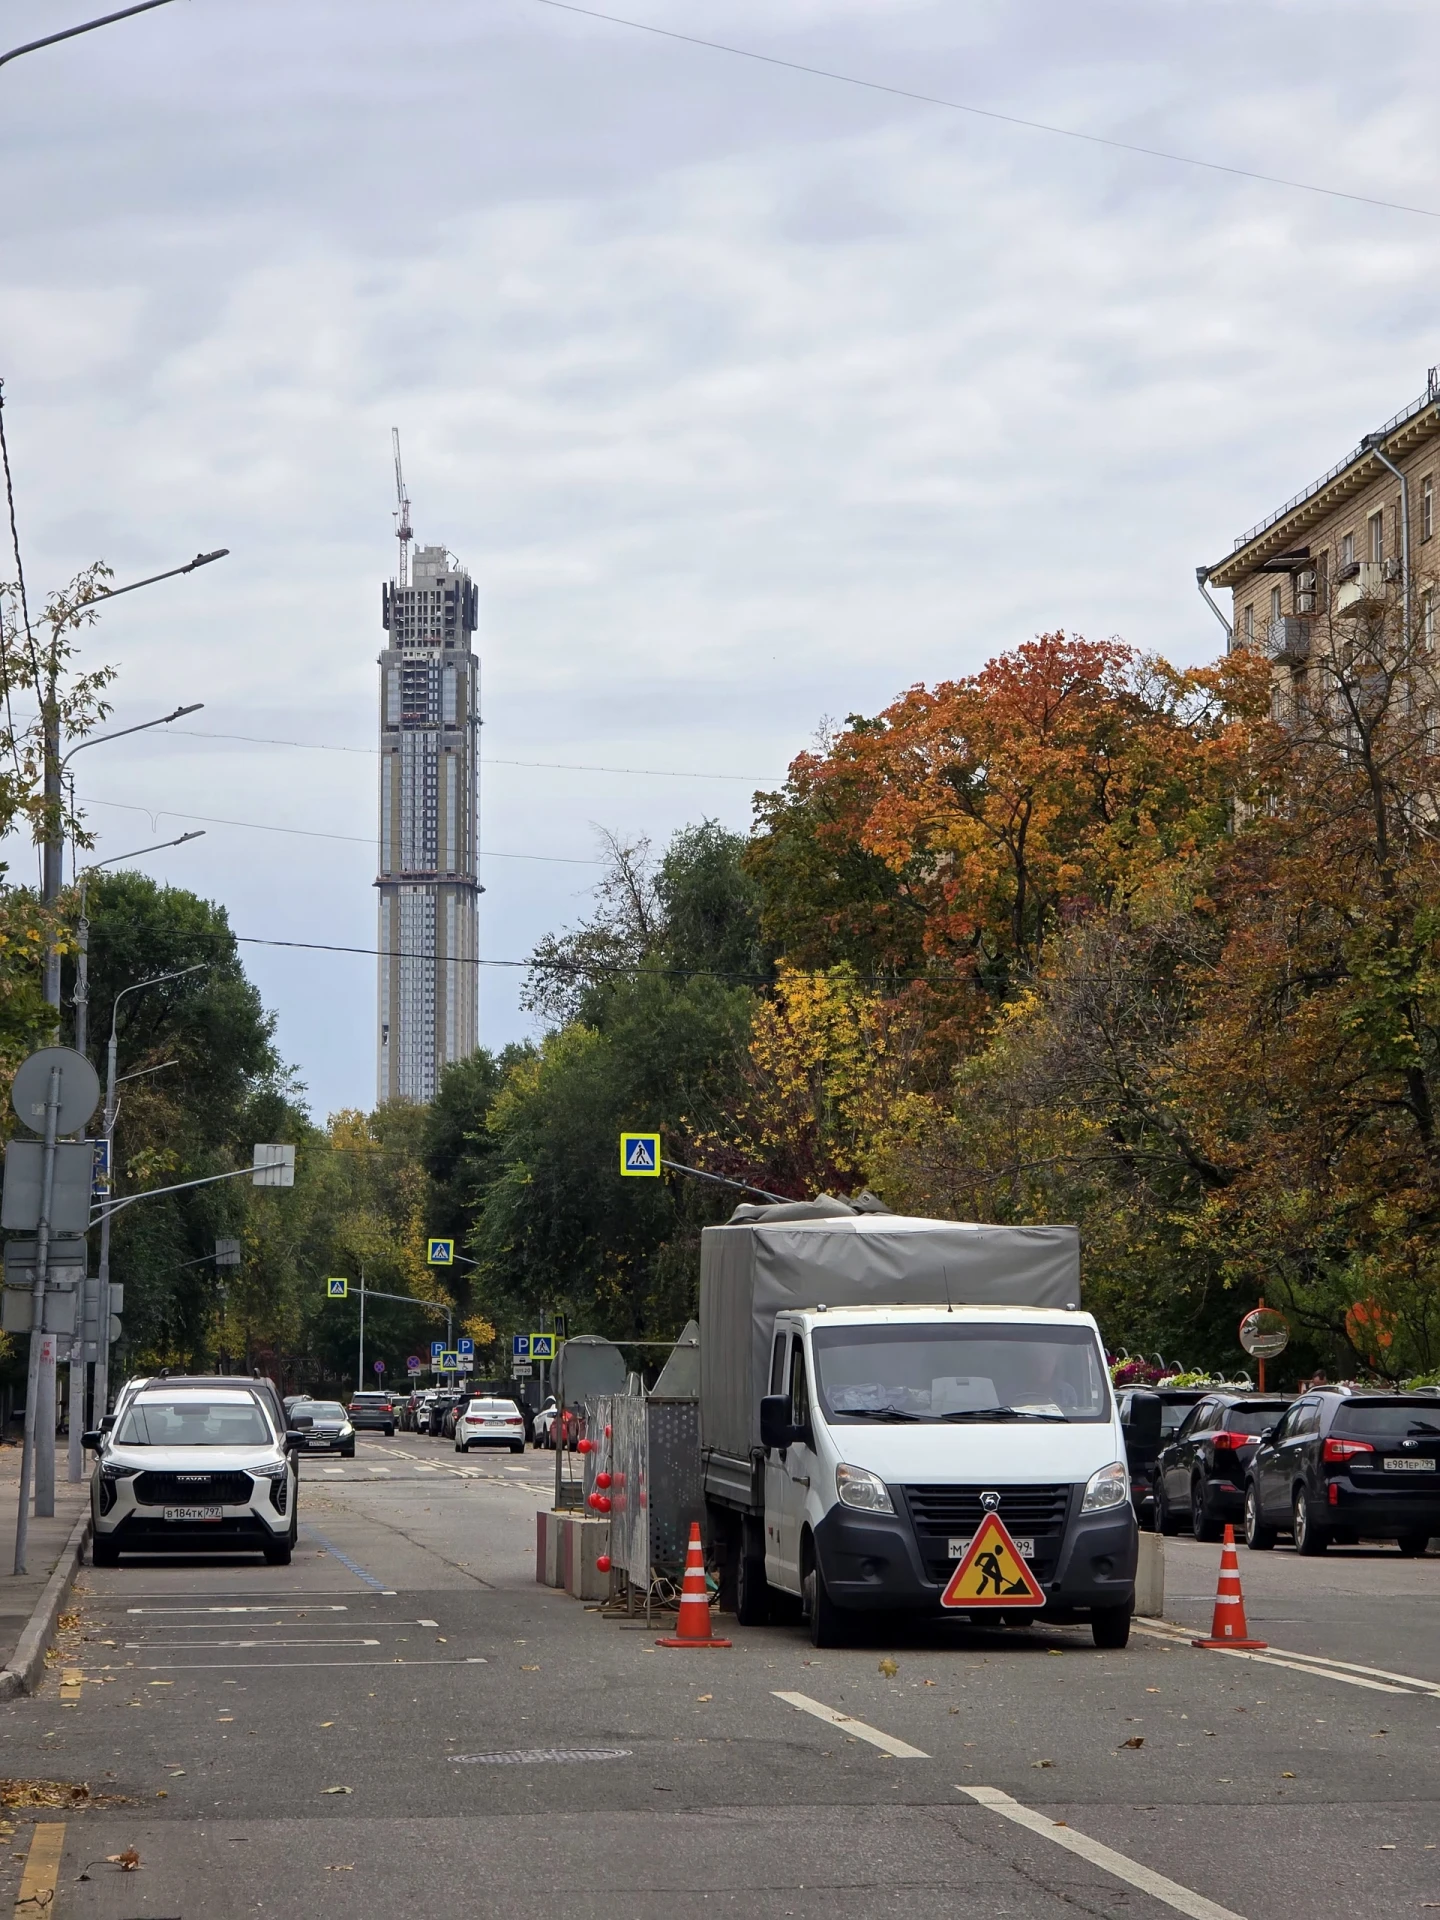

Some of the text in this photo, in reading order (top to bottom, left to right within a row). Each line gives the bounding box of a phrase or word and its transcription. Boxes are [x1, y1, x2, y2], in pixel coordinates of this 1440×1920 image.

[434, 1343, 443, 1355] P
[461, 1340, 470, 1352] P
[518, 1337, 528, 1352] P
[167, 1507, 219, 1518] В184ТК 797
